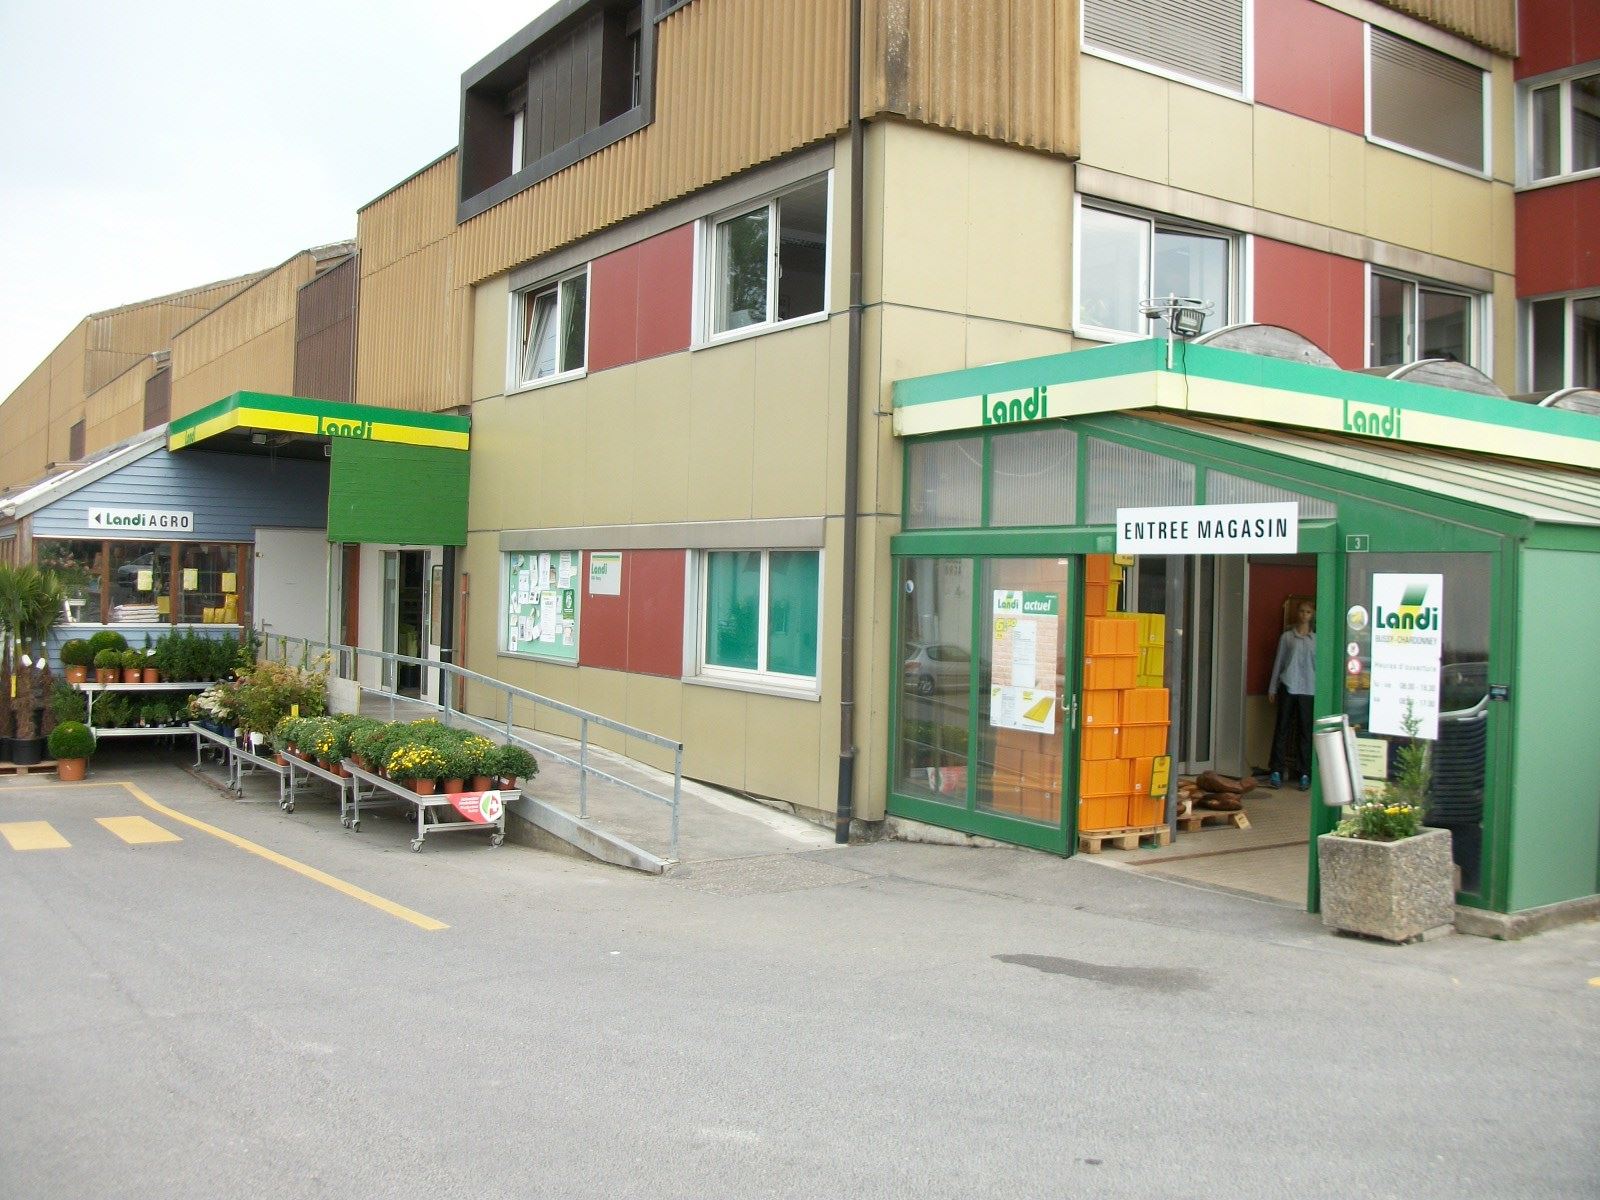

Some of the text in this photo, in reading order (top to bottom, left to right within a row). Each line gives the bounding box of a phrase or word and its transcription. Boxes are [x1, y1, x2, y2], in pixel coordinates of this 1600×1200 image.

[982, 385, 1047, 425] Landi
[318, 415, 372, 440] Landi
[1343, 399, 1401, 438] Landi
[106, 512, 189, 528] Landi AGRO
[1124, 518, 1288, 540] ENTREE MAGASIN
[1355, 537, 1361, 550] 3
[997, 599, 1051, 611] Landi actuel
[1376, 606, 1438, 630] Landi
